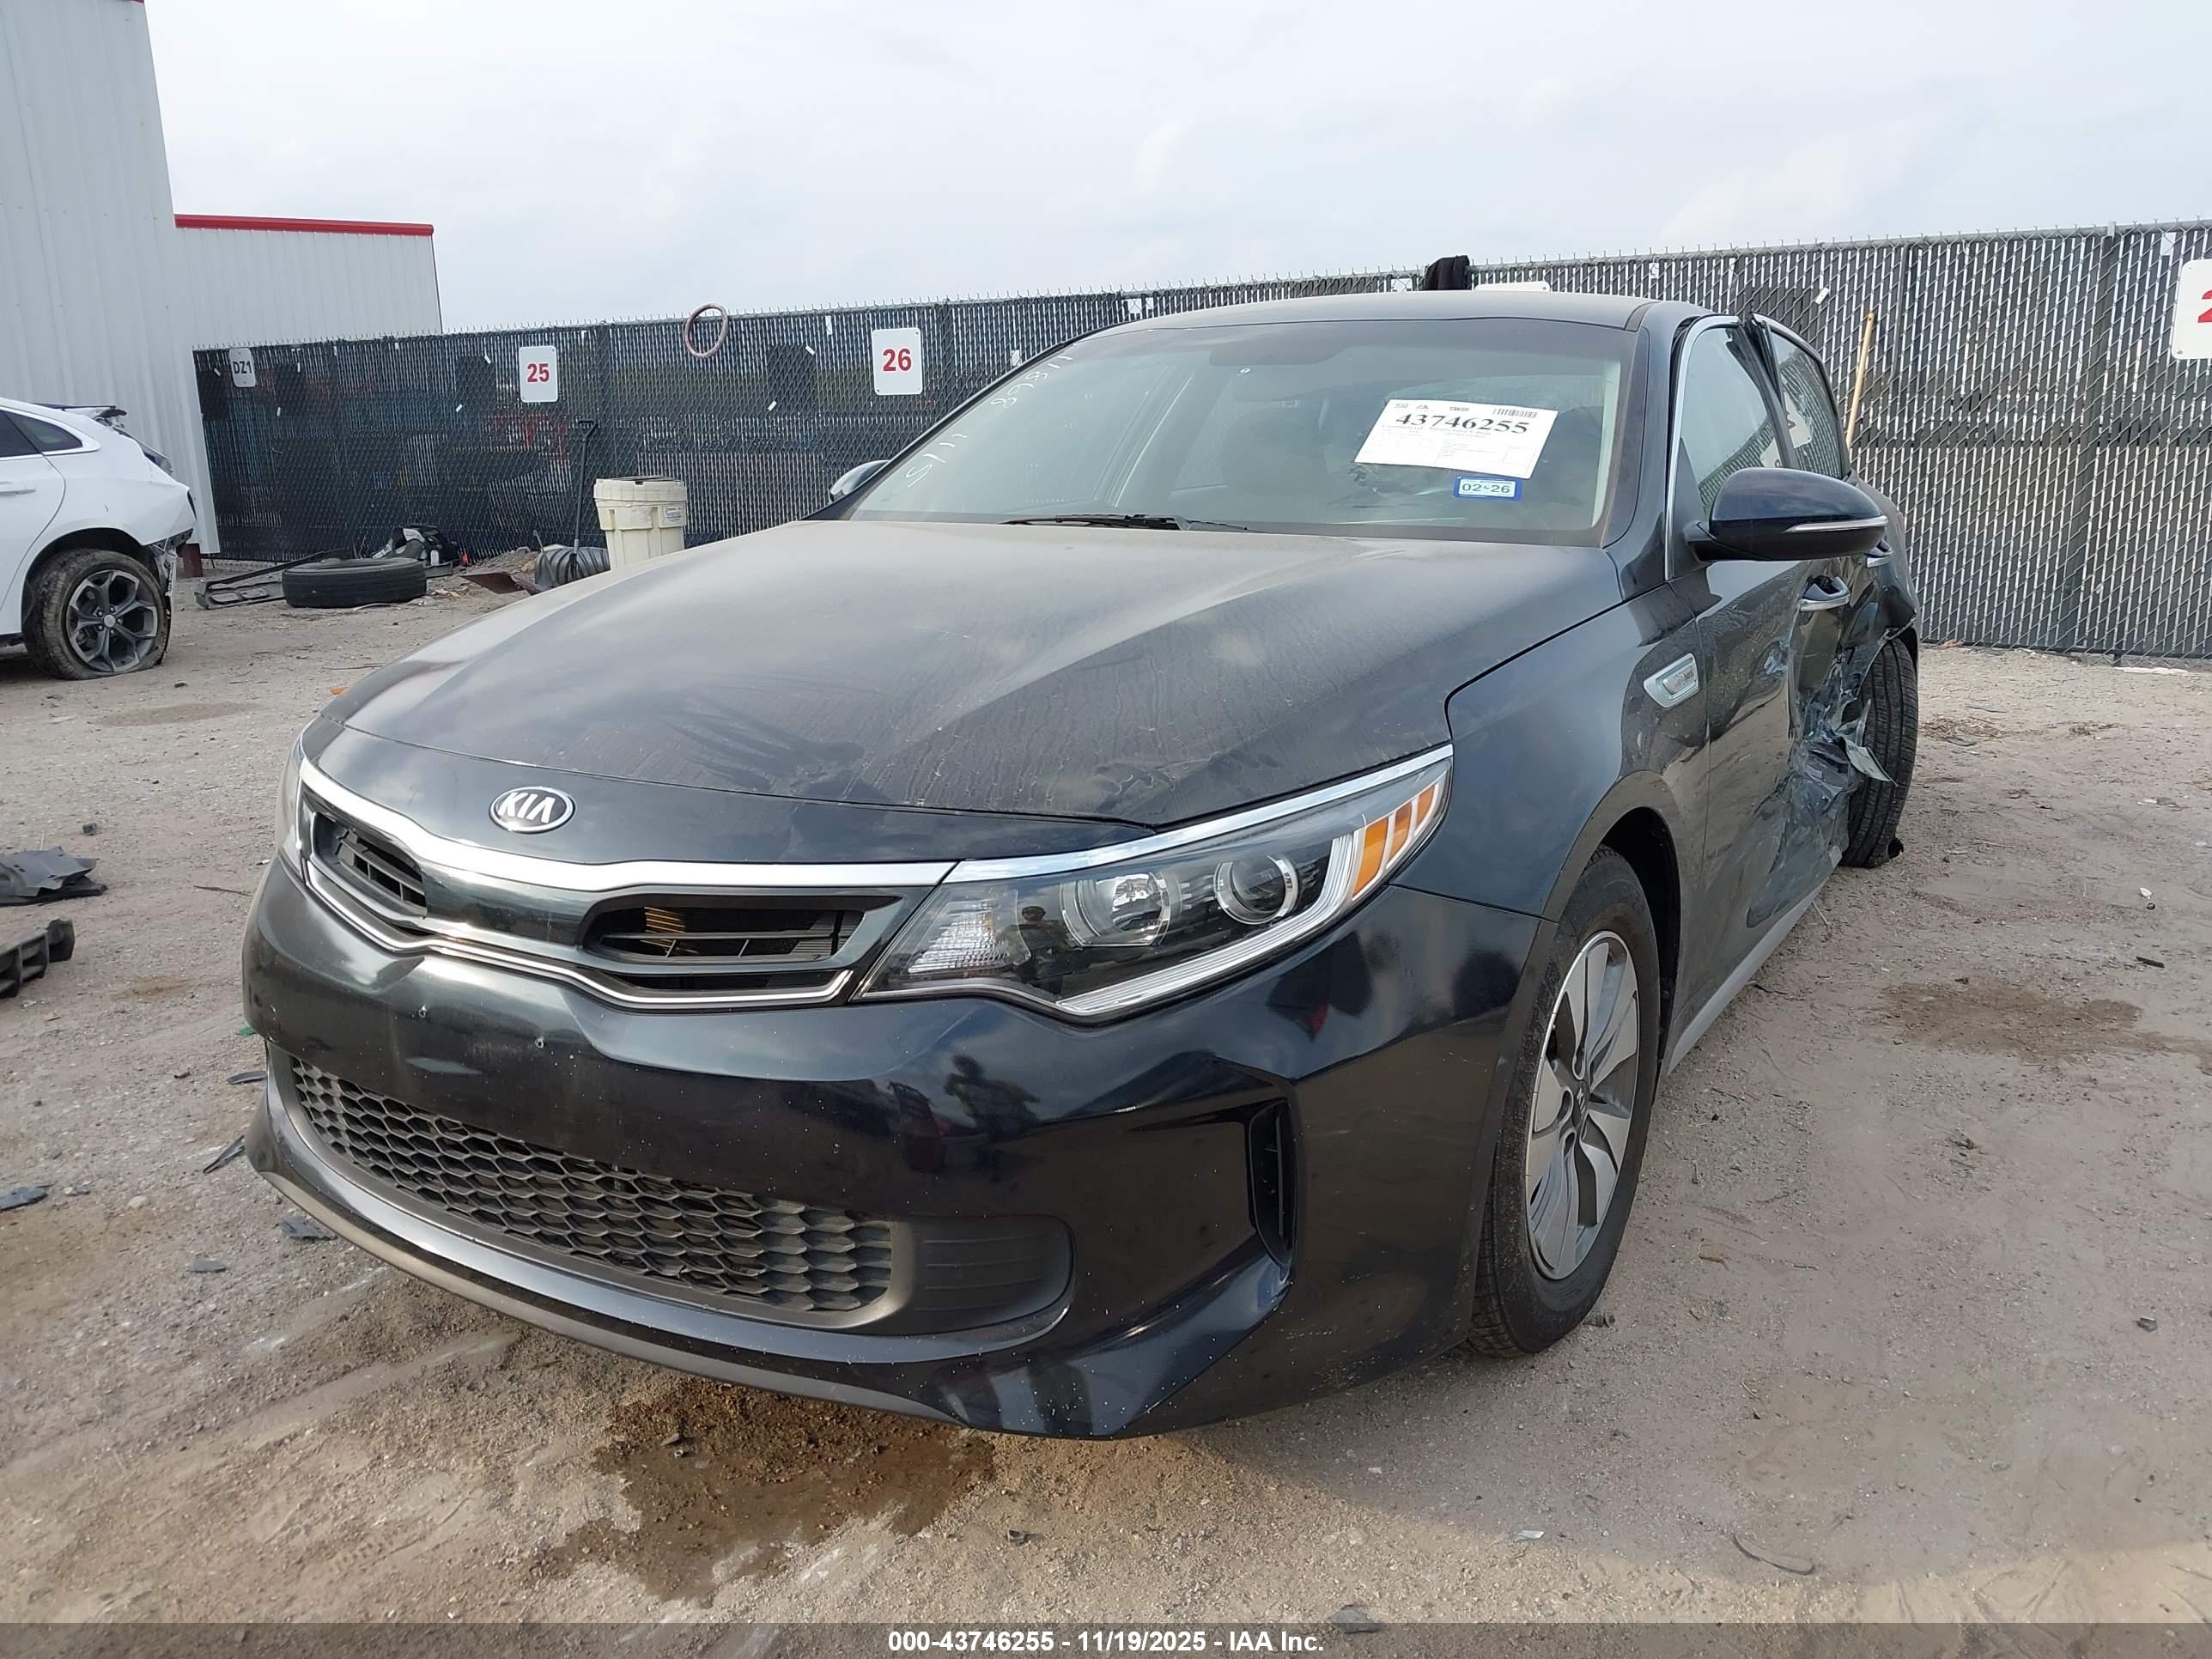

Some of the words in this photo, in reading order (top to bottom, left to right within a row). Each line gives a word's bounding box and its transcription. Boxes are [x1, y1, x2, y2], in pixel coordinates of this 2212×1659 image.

[2197, 289, 2212, 324] 2
[233, 361, 252, 374] DZ1
[883, 348, 912, 372] 26
[527, 362, 550, 382] 25
[1395, 413, 1530, 434] 43746255
[498, 792, 556, 823] KIA
